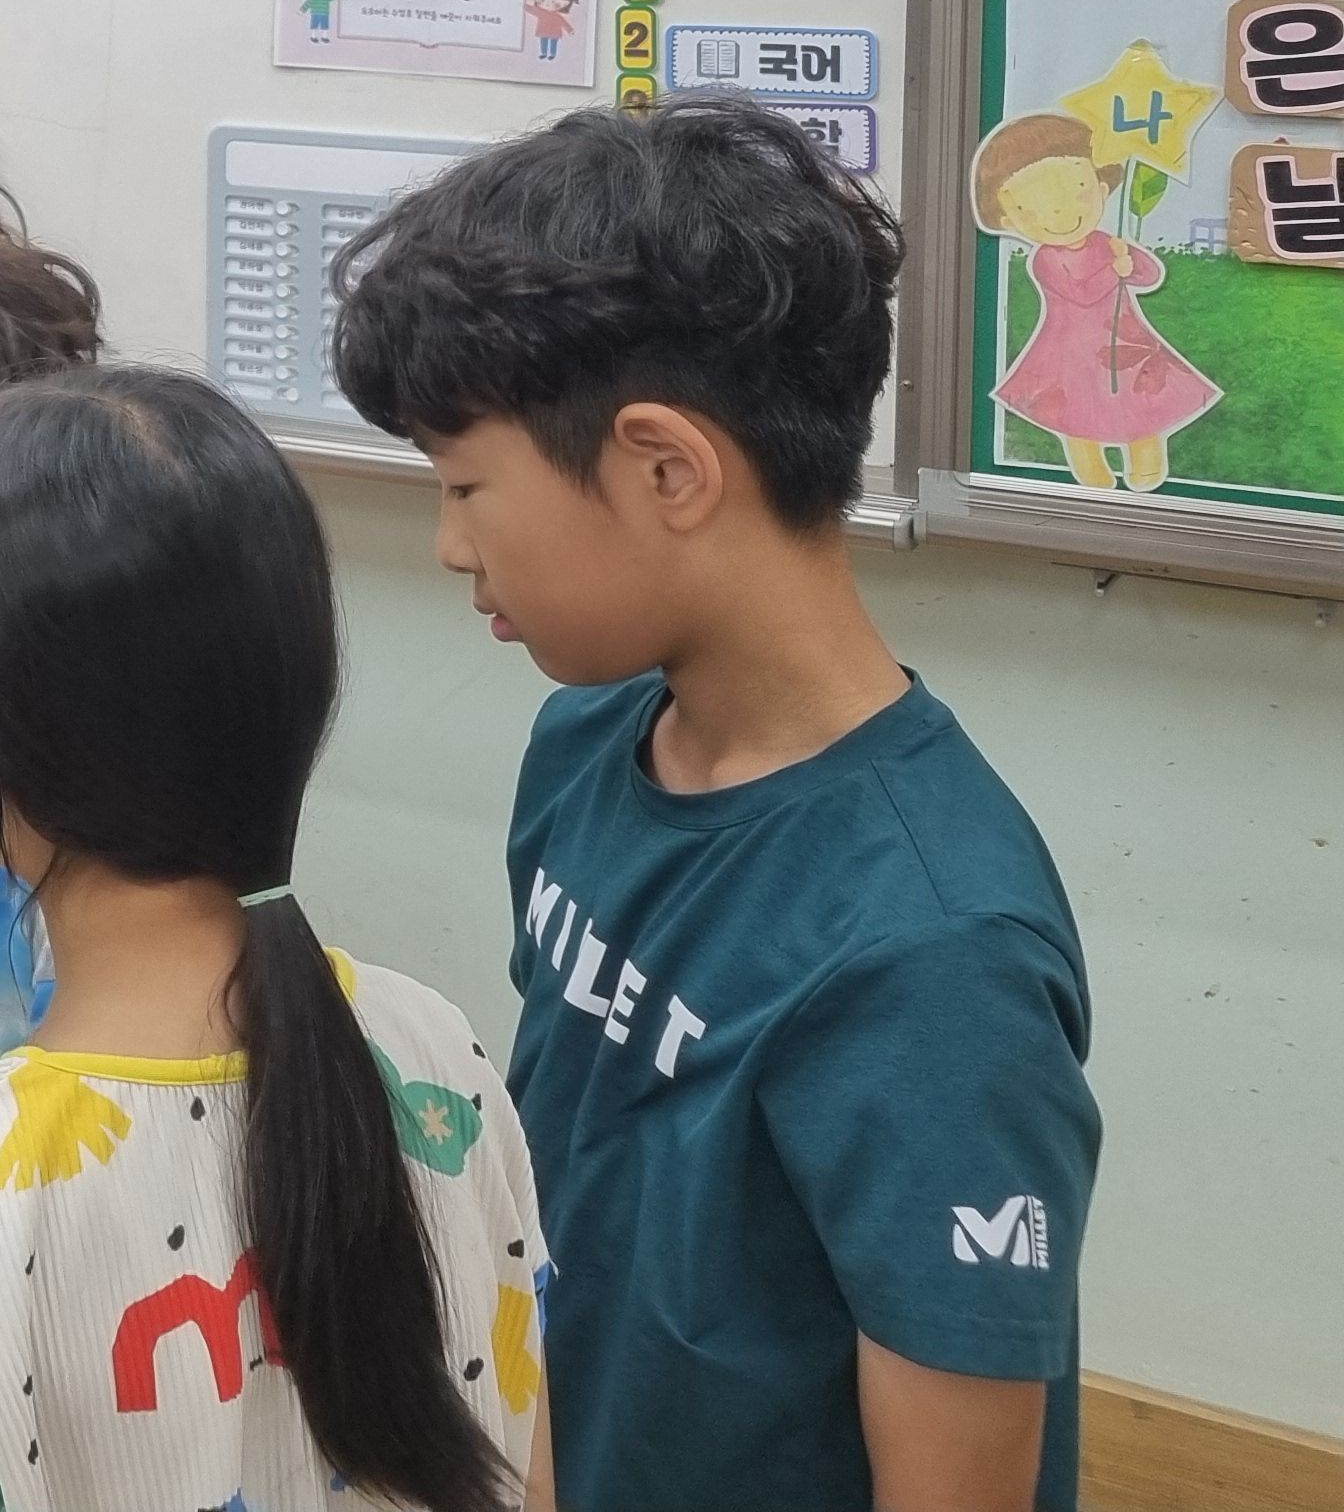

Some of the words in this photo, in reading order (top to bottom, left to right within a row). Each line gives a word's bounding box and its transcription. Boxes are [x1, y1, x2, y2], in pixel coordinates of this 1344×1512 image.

[623, 21, 650, 58] 2
[759, 43, 841, 83] 국어
[1113, 90, 1173, 144] 나
